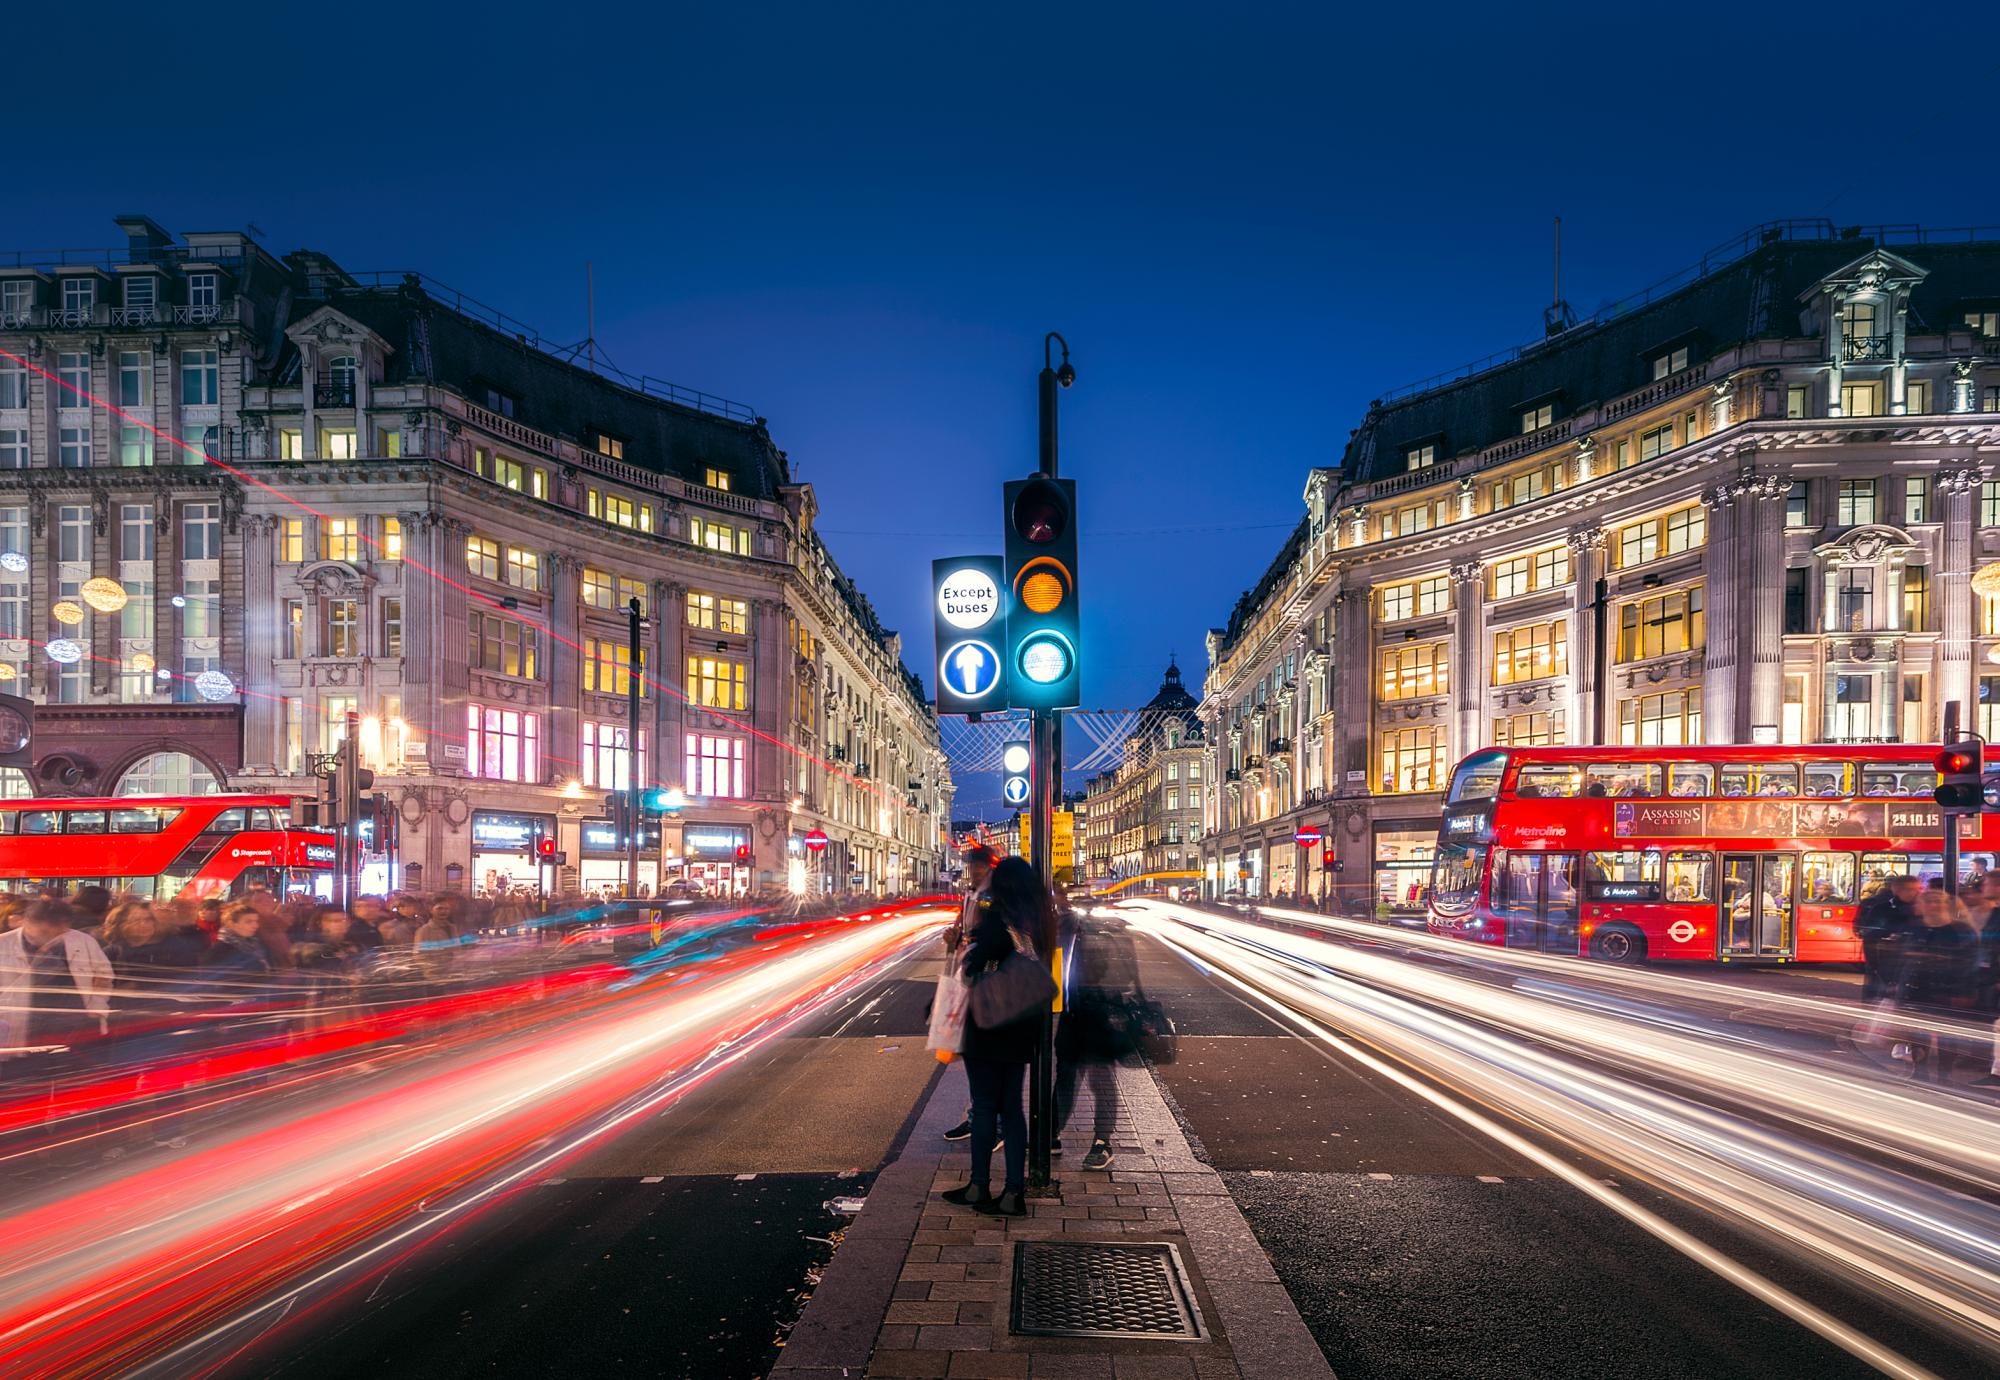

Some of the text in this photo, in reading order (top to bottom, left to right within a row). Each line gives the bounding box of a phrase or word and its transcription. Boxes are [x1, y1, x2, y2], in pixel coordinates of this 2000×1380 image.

[944, 587, 992, 599] Except
[947, 602, 988, 614] buses
[1641, 807, 1700, 821] ASSASSIN'S
[1478, 814, 1485, 831] 6
[1514, 825, 1567, 837] Metroline
[1603, 887, 1637, 897] 6 Aldwych
